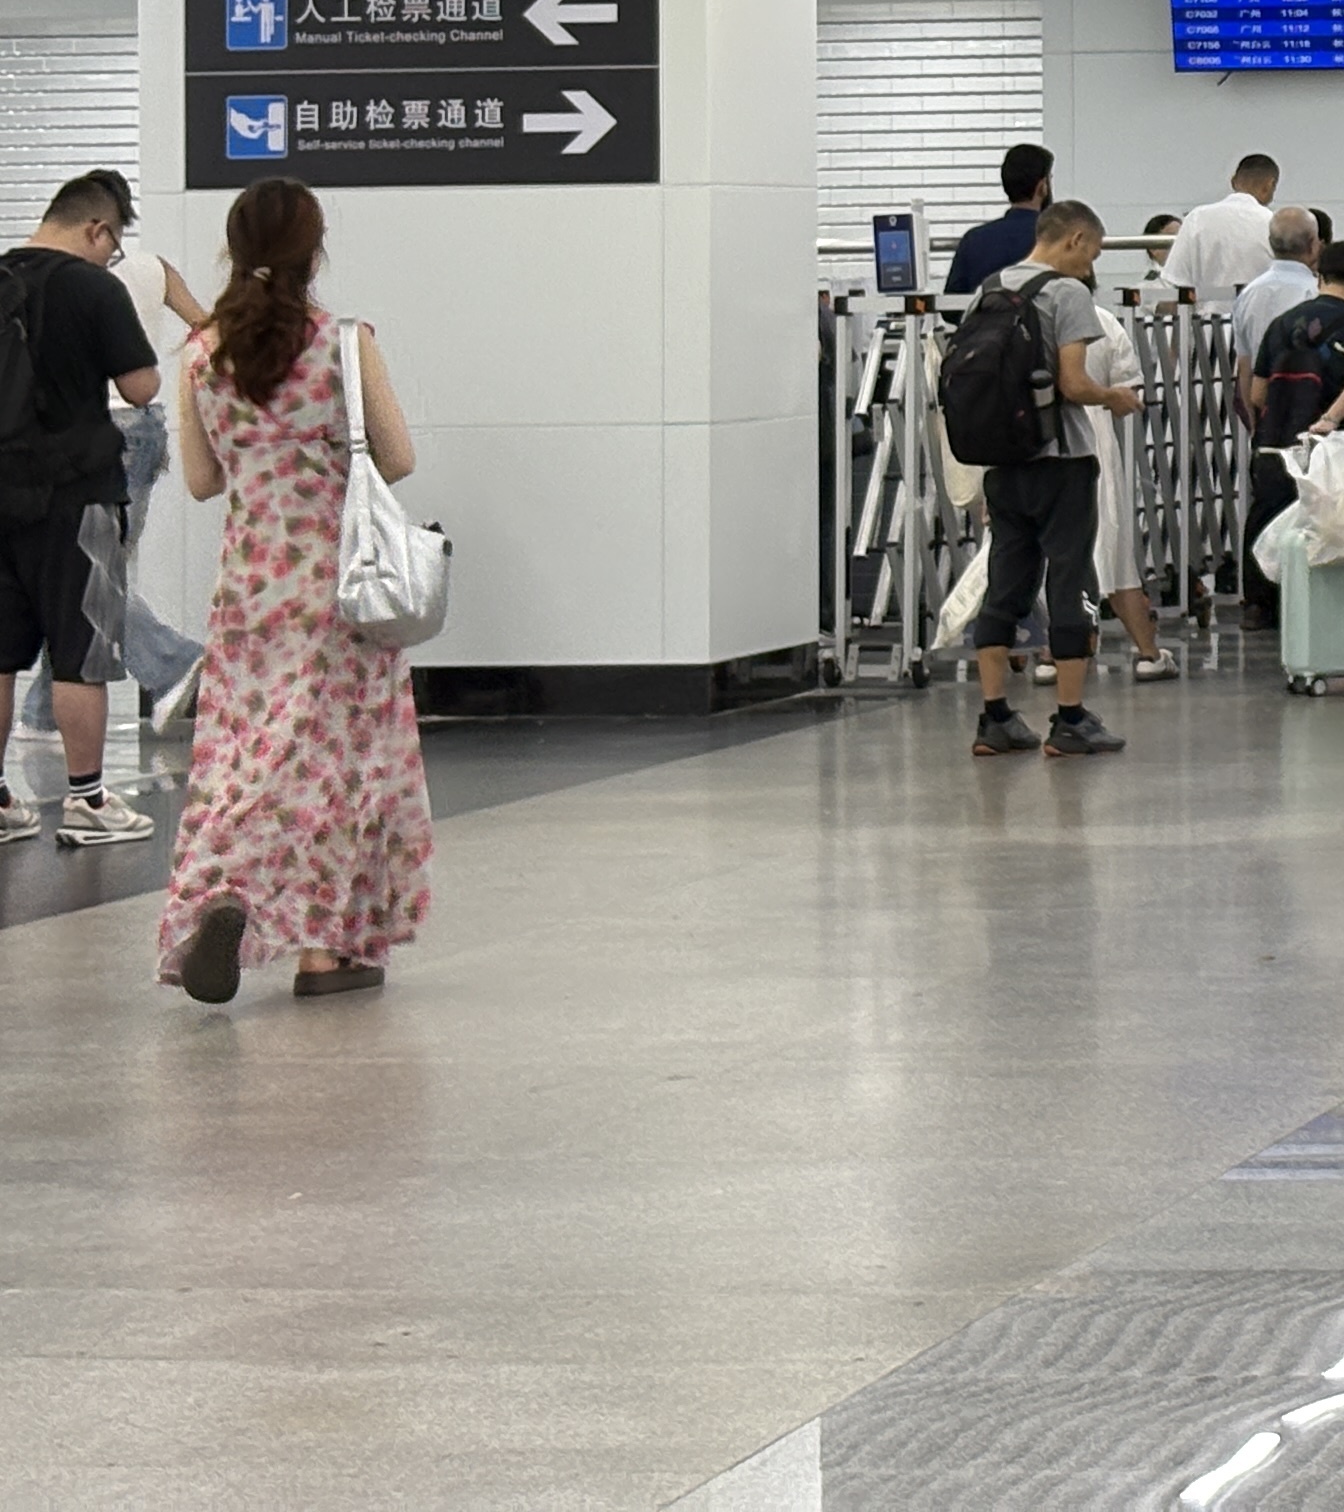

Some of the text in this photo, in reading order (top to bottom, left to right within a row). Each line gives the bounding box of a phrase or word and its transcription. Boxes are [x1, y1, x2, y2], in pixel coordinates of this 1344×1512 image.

[295, 28, 503, 44] Manual Ticket-checking Channel
[296, 98, 504, 131] 自助检票通道
[298, 138, 366, 151] Self-service
[458, 136, 504, 148] channel
